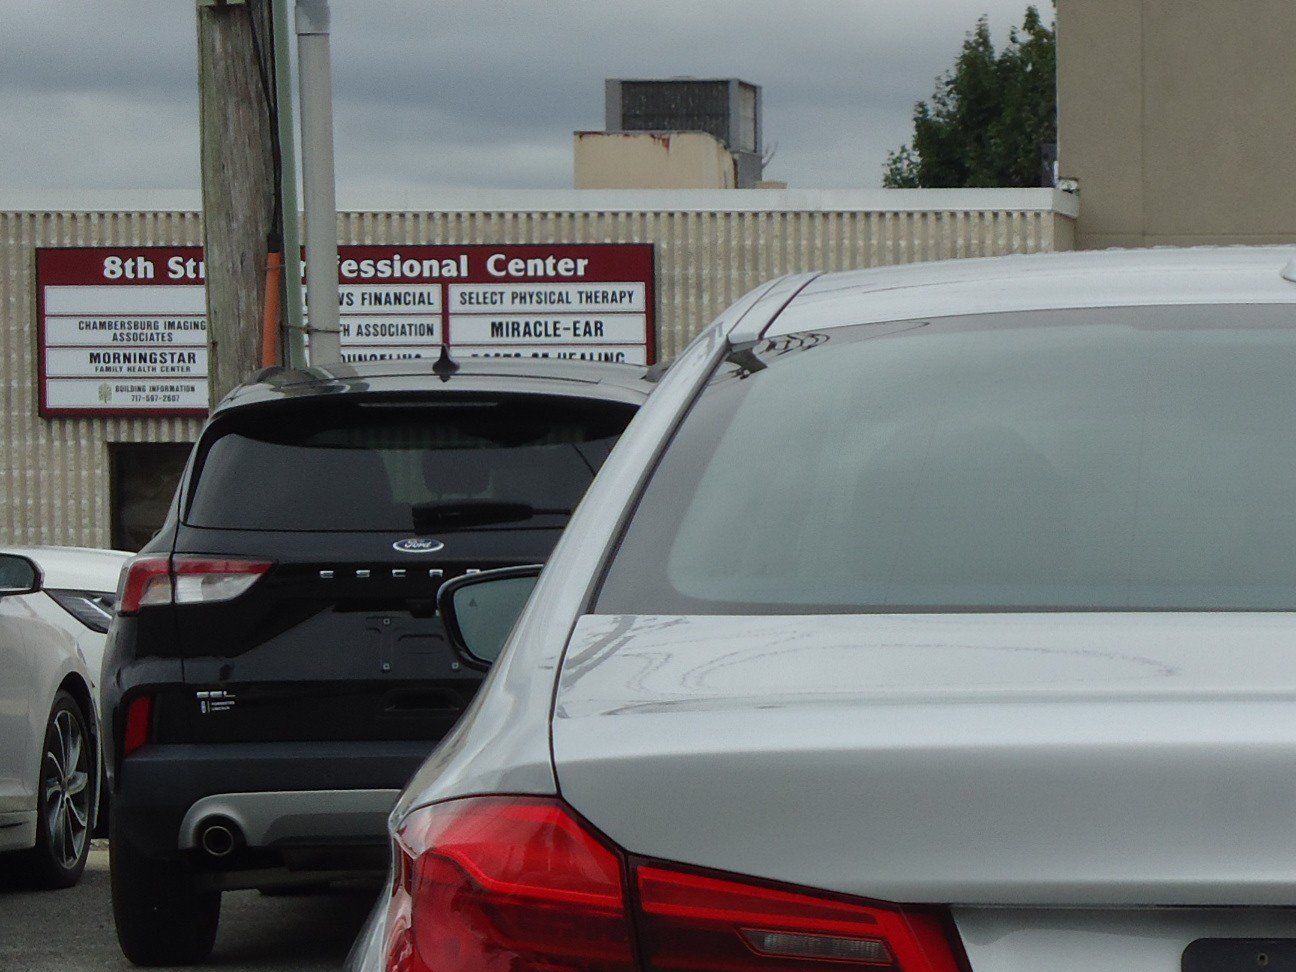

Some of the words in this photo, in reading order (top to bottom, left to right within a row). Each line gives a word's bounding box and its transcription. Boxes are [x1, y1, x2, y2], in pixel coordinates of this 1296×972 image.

[103, 256, 155, 279] 8th
[486, 254, 589, 277] Center
[361, 291, 435, 306] FINANCIAL
[460, 291, 505, 306] SELECT
[511, 291, 572, 305] PHYSICAL
[577, 290, 635, 304] THERAPY
[78, 320, 160, 331] CHAMBERSBURG
[163, 320, 207, 331] IMAGING
[356, 323, 435, 337] ASSOCIATION
[490, 320, 604, 338] MIRACLE-EAR
[112, 332, 174, 342] ASSOCIATES
[89, 352, 197, 364] MORNINGSTAR
